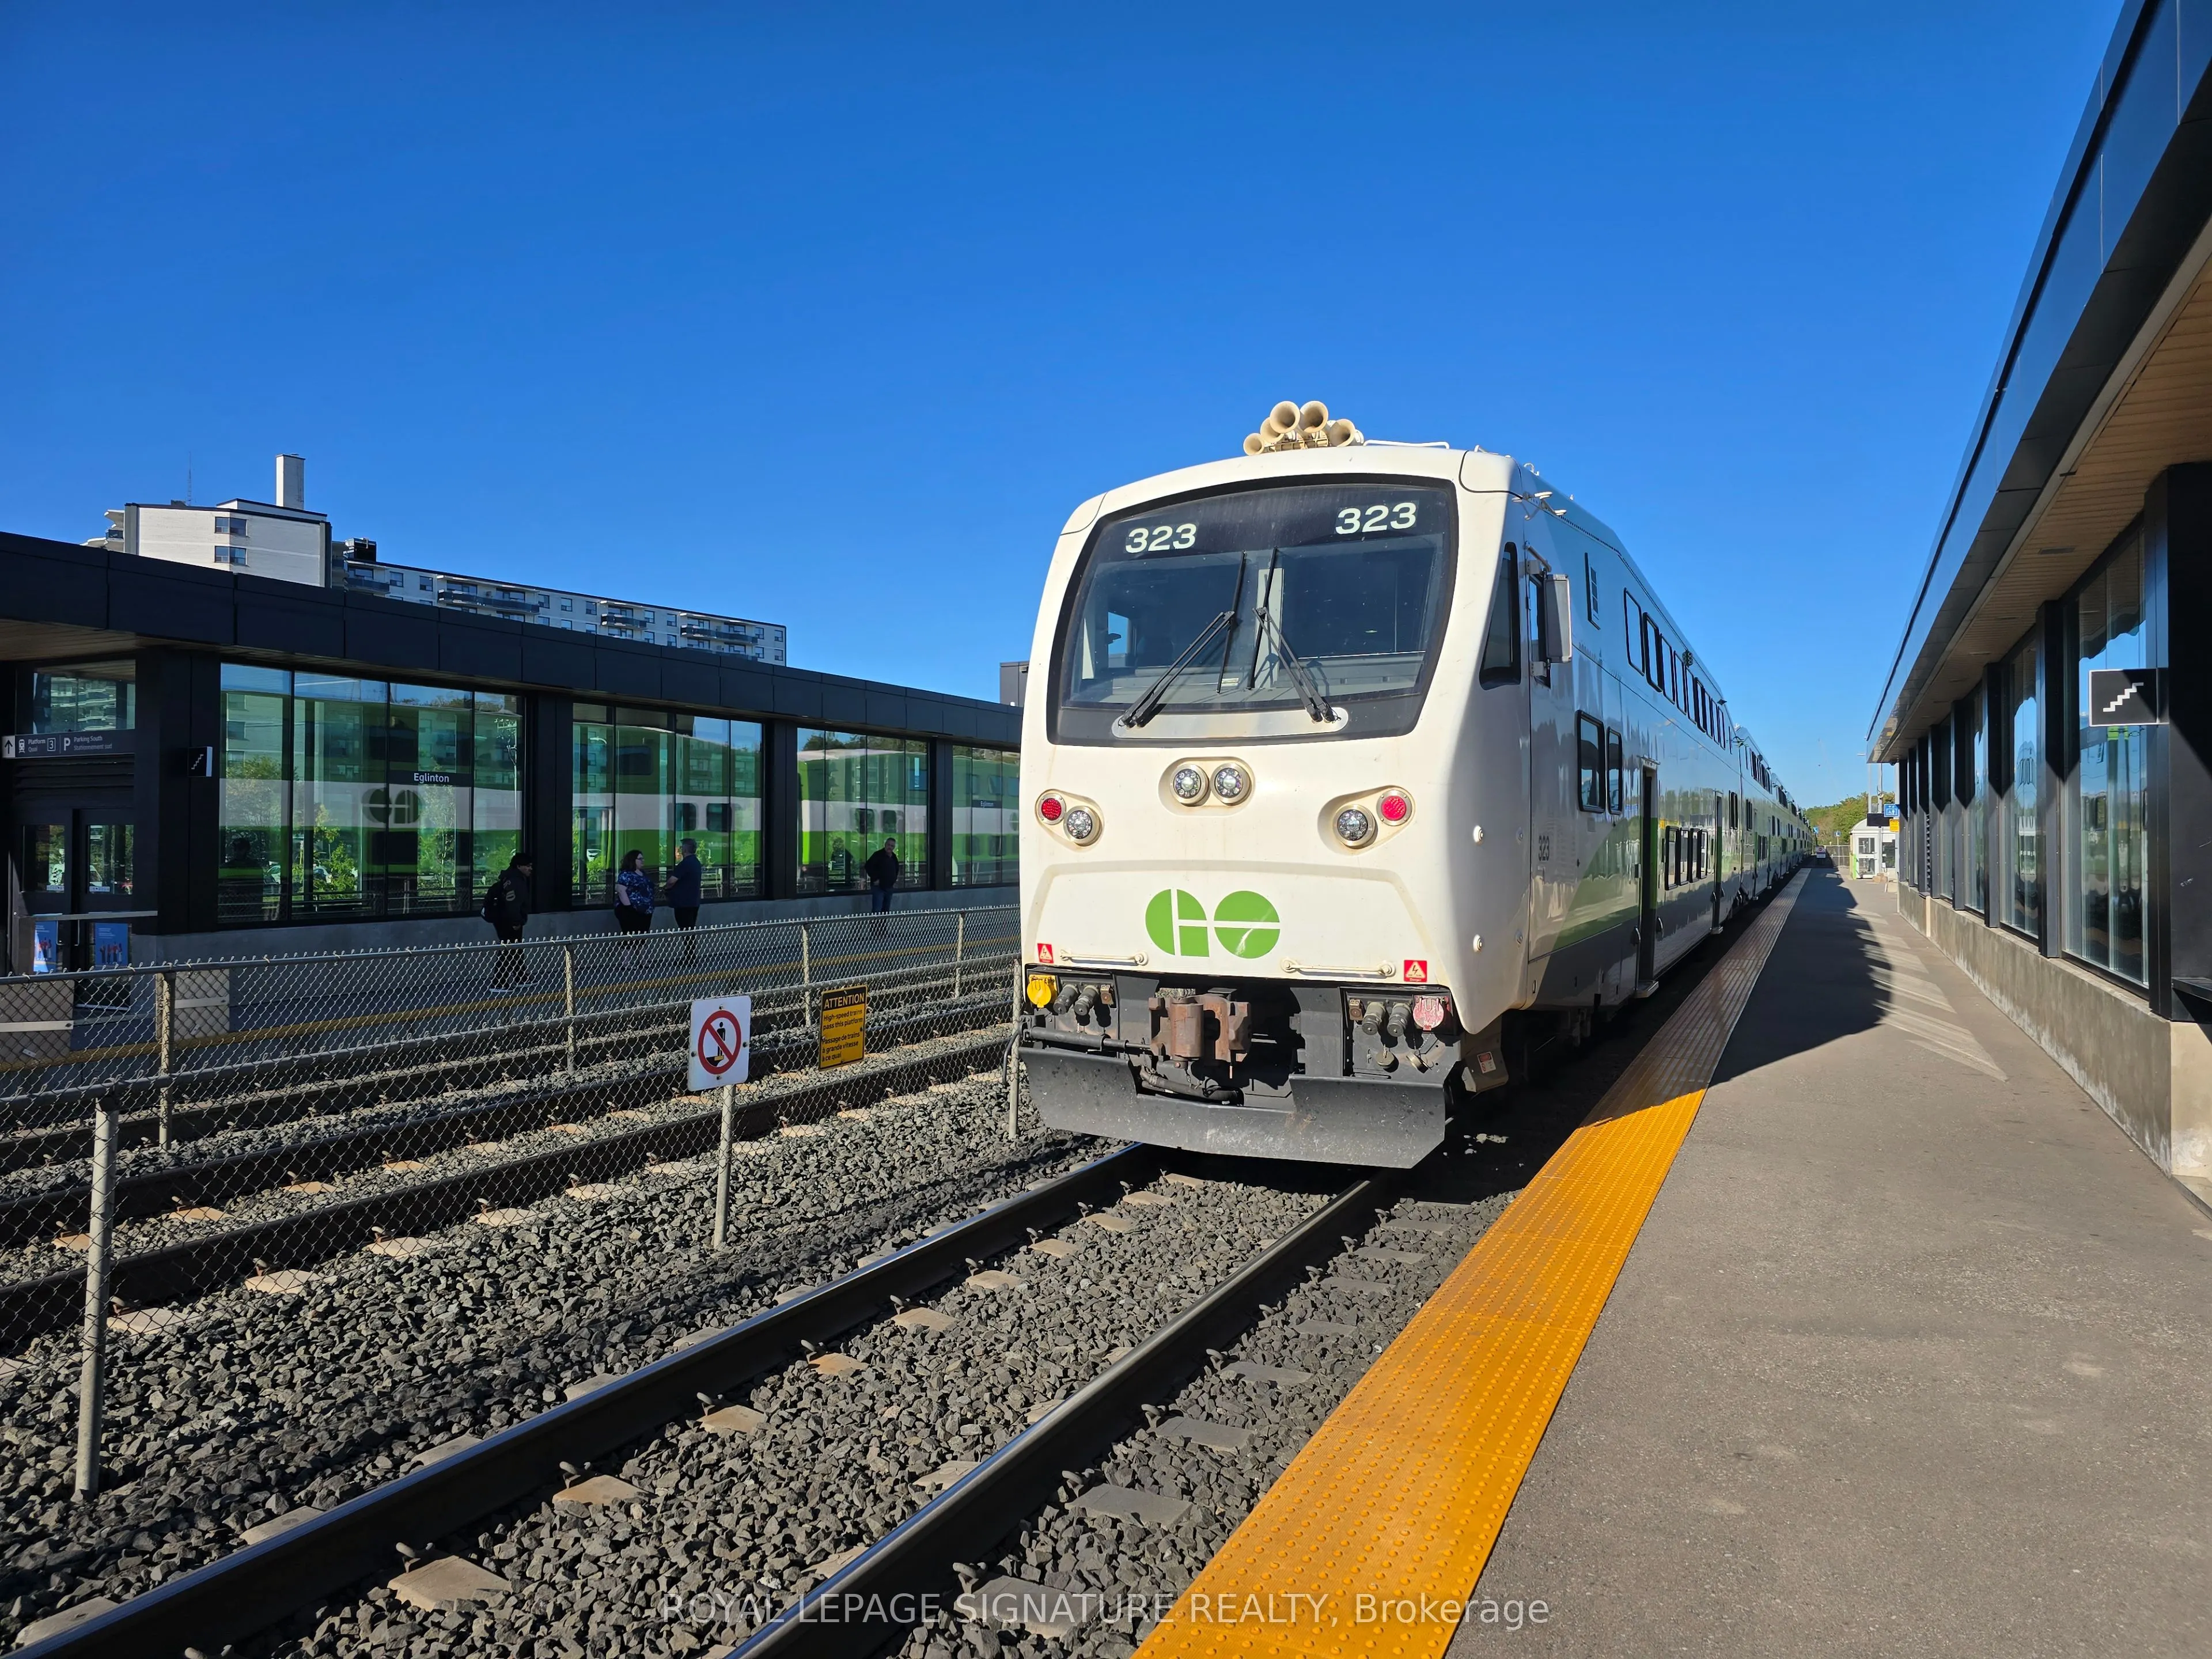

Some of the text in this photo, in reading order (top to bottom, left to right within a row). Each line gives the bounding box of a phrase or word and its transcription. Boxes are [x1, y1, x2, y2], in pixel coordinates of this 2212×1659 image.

[1335, 502, 1417, 535] 323
[1126, 523, 1197, 553] 323
[414, 772, 449, 784] Eglinton
[1538, 835, 1550, 861] 323
[824, 993, 865, 1009] ATTENTION
[823, 1010, 850, 1022] High-speed
[844, 1017, 863, 1027] platform
[826, 1043, 842, 1054] grande
[831, 1051, 842, 1059] quai
